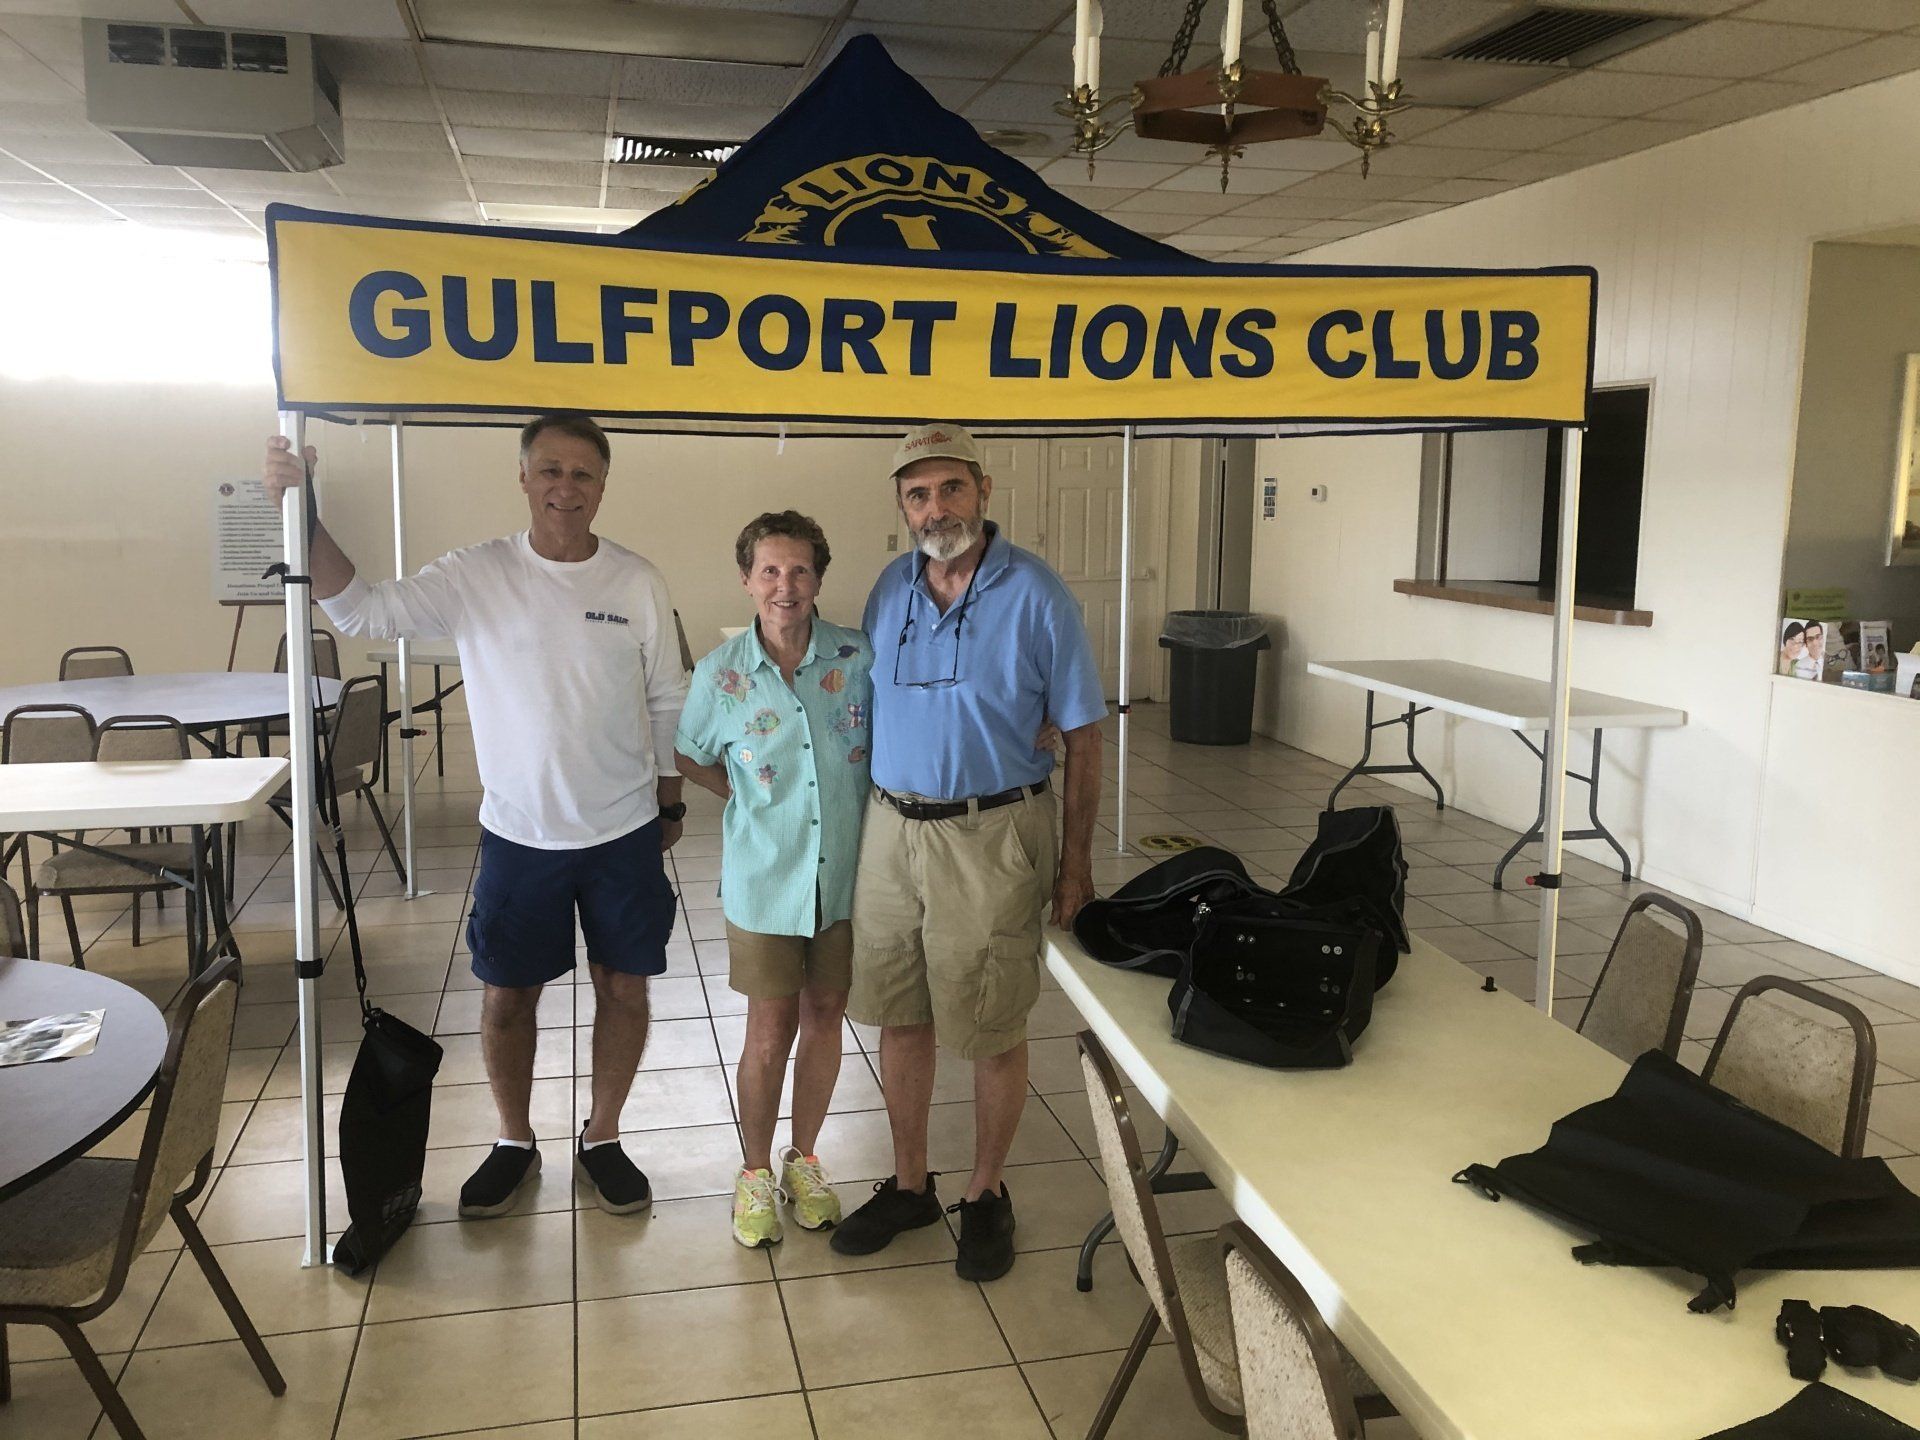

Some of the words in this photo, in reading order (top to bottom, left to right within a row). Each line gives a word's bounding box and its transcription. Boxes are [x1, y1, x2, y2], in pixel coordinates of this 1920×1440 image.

[796, 157, 1012, 211] LIONS
[349, 271, 957, 377] GULFPORT
[989, 302, 1276, 381] LIONS
[1307, 308, 1540, 381] CLUB
[585, 611, 605, 620] OLD
